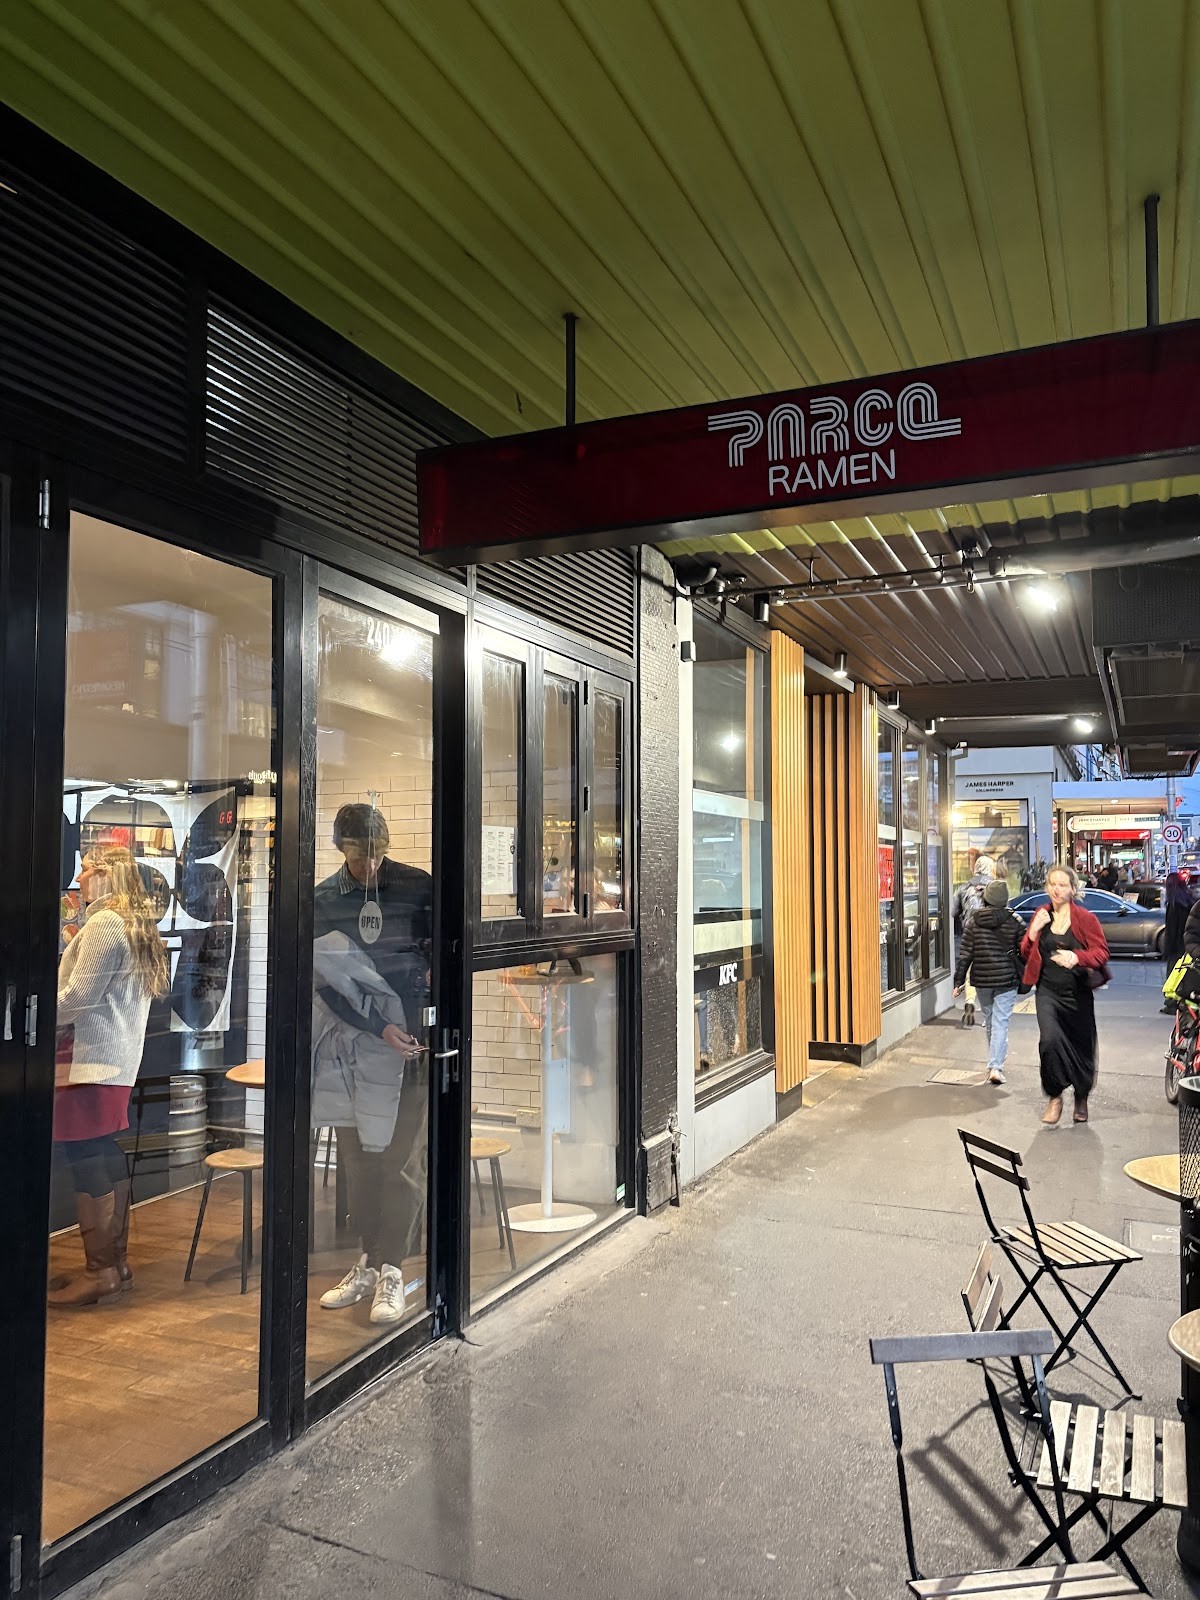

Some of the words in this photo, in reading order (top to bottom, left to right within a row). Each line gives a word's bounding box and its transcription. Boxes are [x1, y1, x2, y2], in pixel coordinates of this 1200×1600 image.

[769, 449, 896, 496] RAMEN
[1166, 829, 1178, 838] 30
[361, 916, 380, 929] OPEN
[718, 962, 738, 986] KFC
